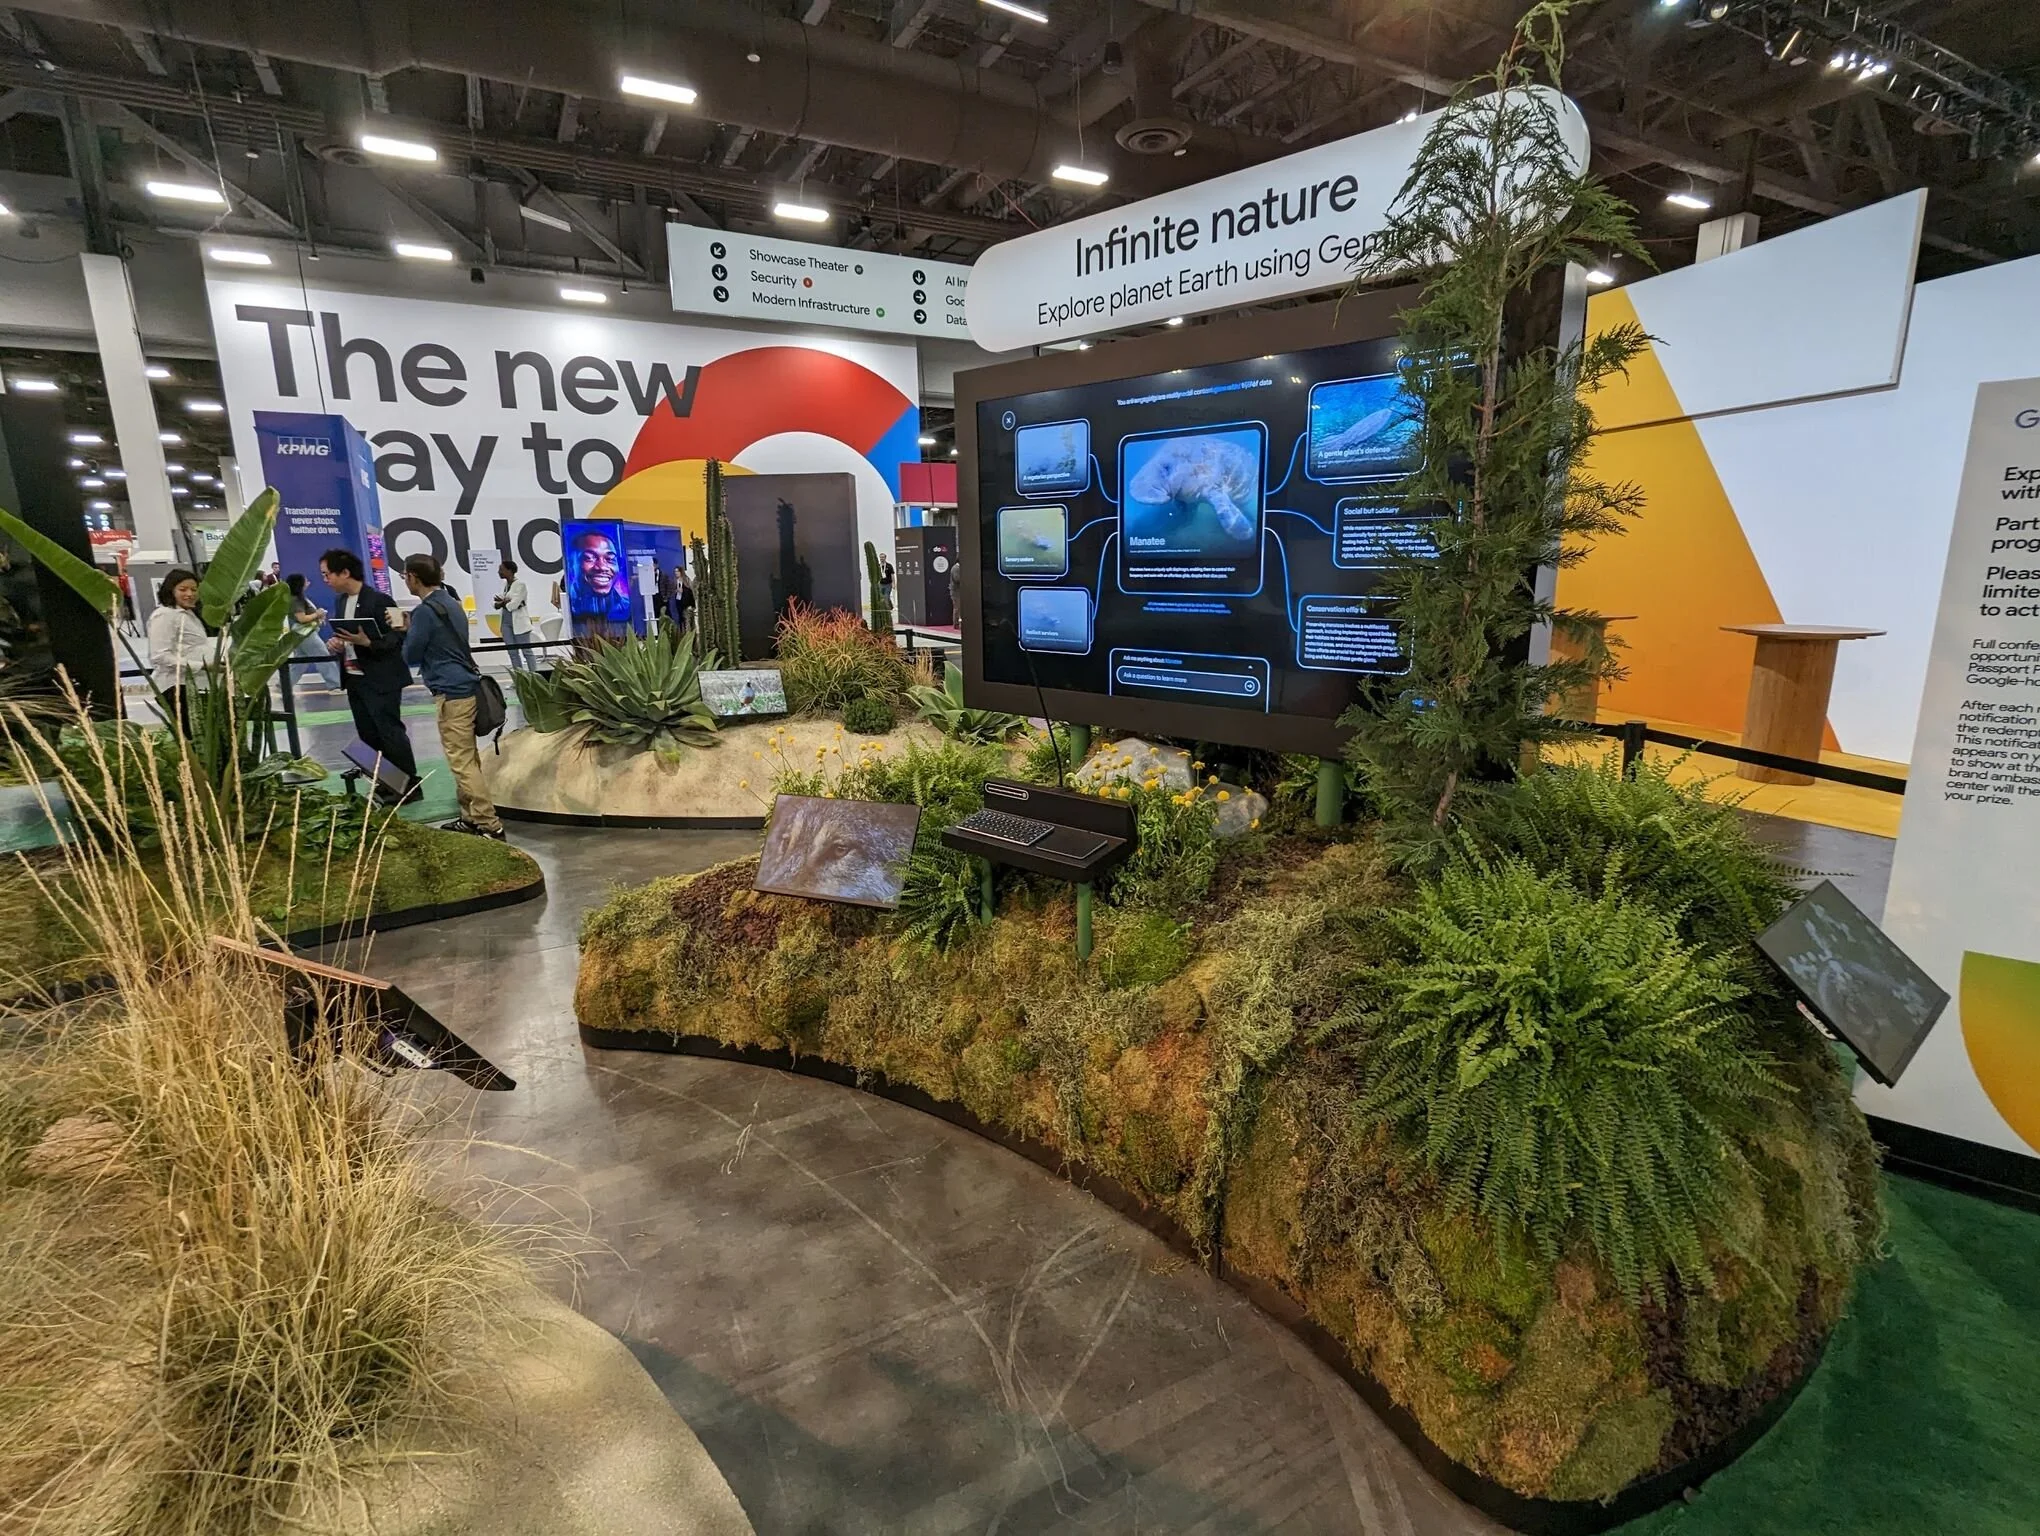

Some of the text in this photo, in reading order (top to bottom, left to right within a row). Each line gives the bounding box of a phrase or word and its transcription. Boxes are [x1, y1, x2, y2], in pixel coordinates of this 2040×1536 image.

[1077, 174, 1359, 277] Infinite nature
[749, 249, 849, 272] Showcase Theater
[751, 270, 797, 288] Security
[1038, 295, 1105, 327] Explore
[1110, 275, 1172, 316] planet
[1179, 260, 1238, 295] Earth
[1245, 248, 1311, 277] using
[752, 291, 870, 316] Modern Infrastructure
[235, 304, 701, 419] The new
[277, 443, 330, 456] KPMG
[1324, 450, 1343, 458] gentle
[1344, 448, 1364, 457] giant's
[357, 422, 626, 516] ay to
[284, 507, 341, 516] Transformation
[313, 517, 337, 525] stops.
[290, 526, 317, 534] Neither
[1129, 537, 1166, 546] Manatee
[1306, 605, 1345, 613] Conservation
[1979, 603, 2001, 616] to
[1972, 638, 1996, 649] Full
[1968, 662, 2030, 675] Passport
[1960, 700, 1997, 711] After
[1999, 703, 2034, 713] each
[1958, 712, 2037, 725] notification
[1957, 723, 1980, 733] the
[1955, 733, 1982, 745] This
[1952, 747, 2008, 759] appears
[2010, 752, 2029, 760] on
[1951, 758, 1965, 766] to
[1967, 758, 2005, 769] show
[2007, 762, 2021, 771] at
[1948, 767, 1989, 780] brand
[1946, 780, 1990, 791] center
[1993, 784, 2014, 794] will
[1944, 792, 2014, 805] your prize.
